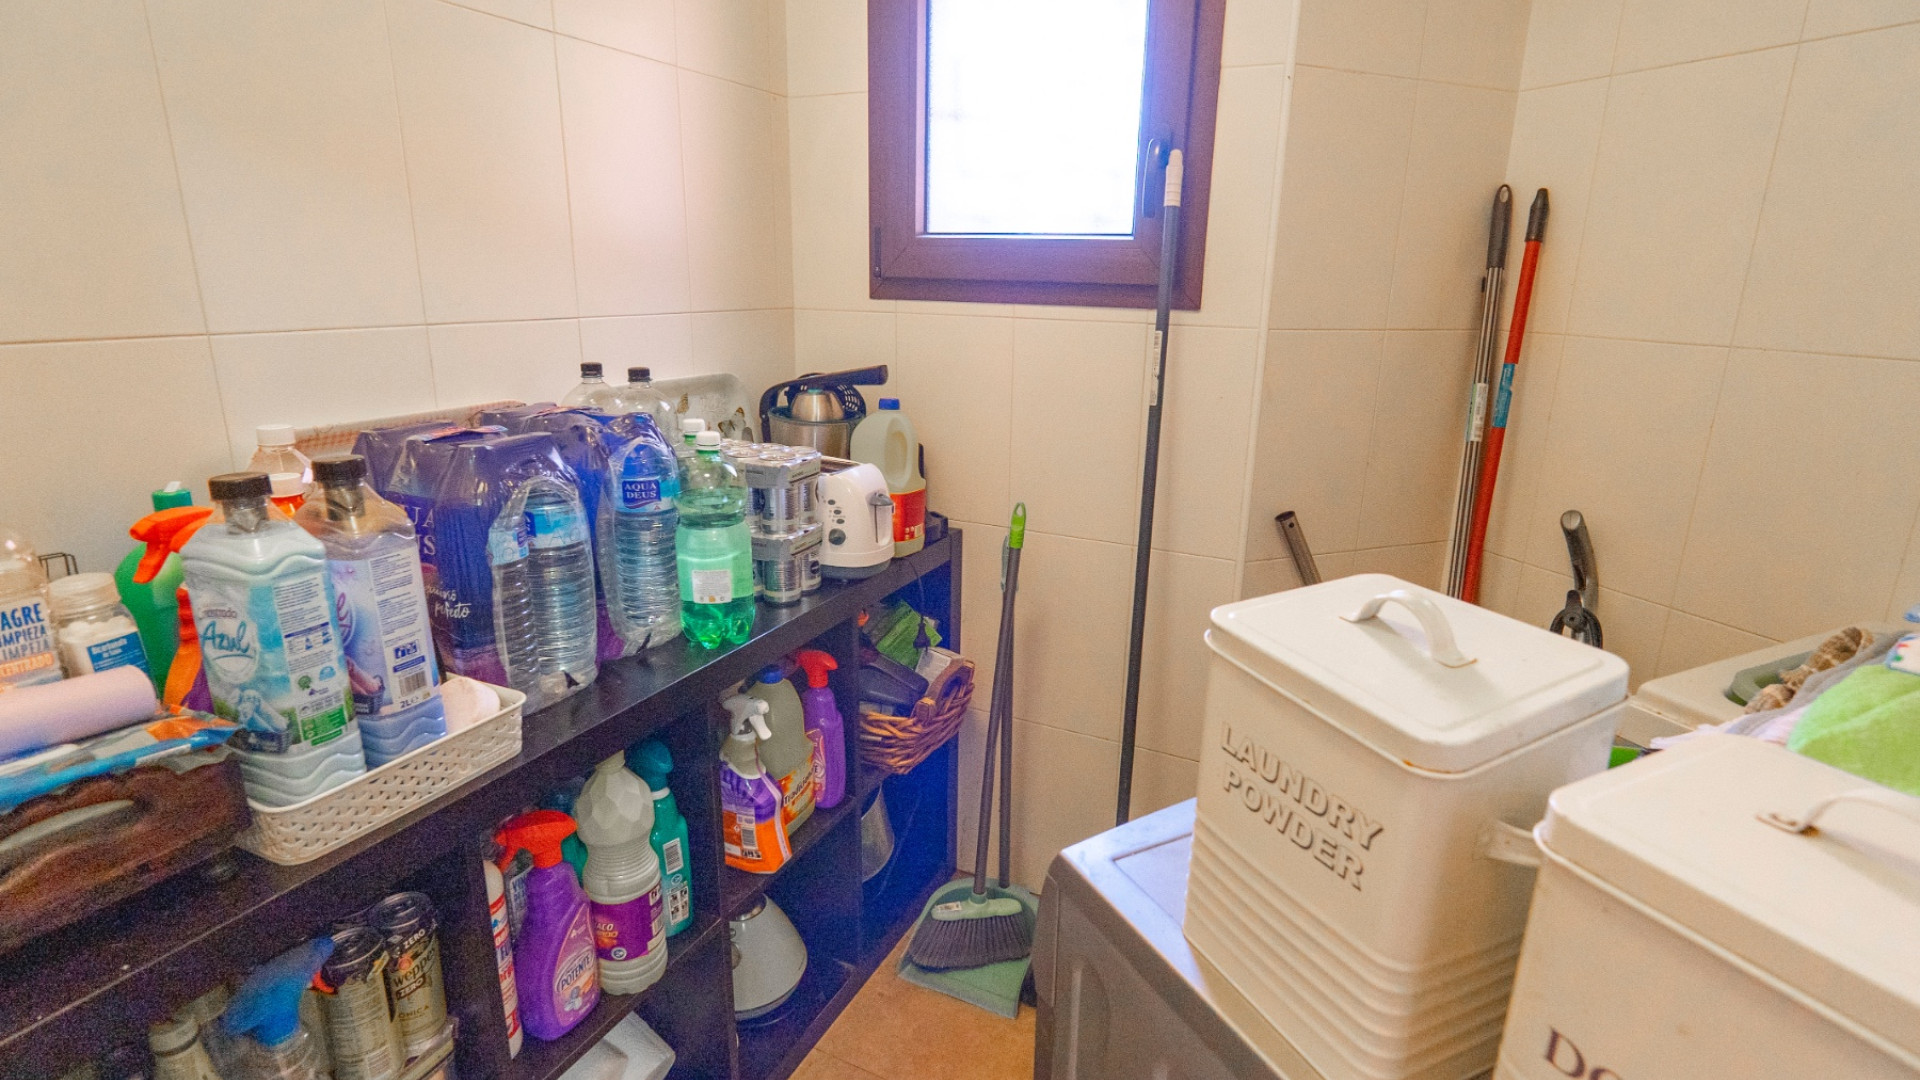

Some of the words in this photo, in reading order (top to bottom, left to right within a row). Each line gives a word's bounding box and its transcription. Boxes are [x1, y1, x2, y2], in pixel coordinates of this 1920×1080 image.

[624, 483, 657, 492] AQUA
[626, 491, 657, 499] DEUS
[0, 603, 45, 631] AGRE
[199, 620, 250, 653] Azul
[1220, 722, 1384, 850] LAUNDRY
[1222, 763, 1364, 891] POWDER
[403, 929, 426, 949] ZERO
[560, 953, 591, 990] POTENTE
